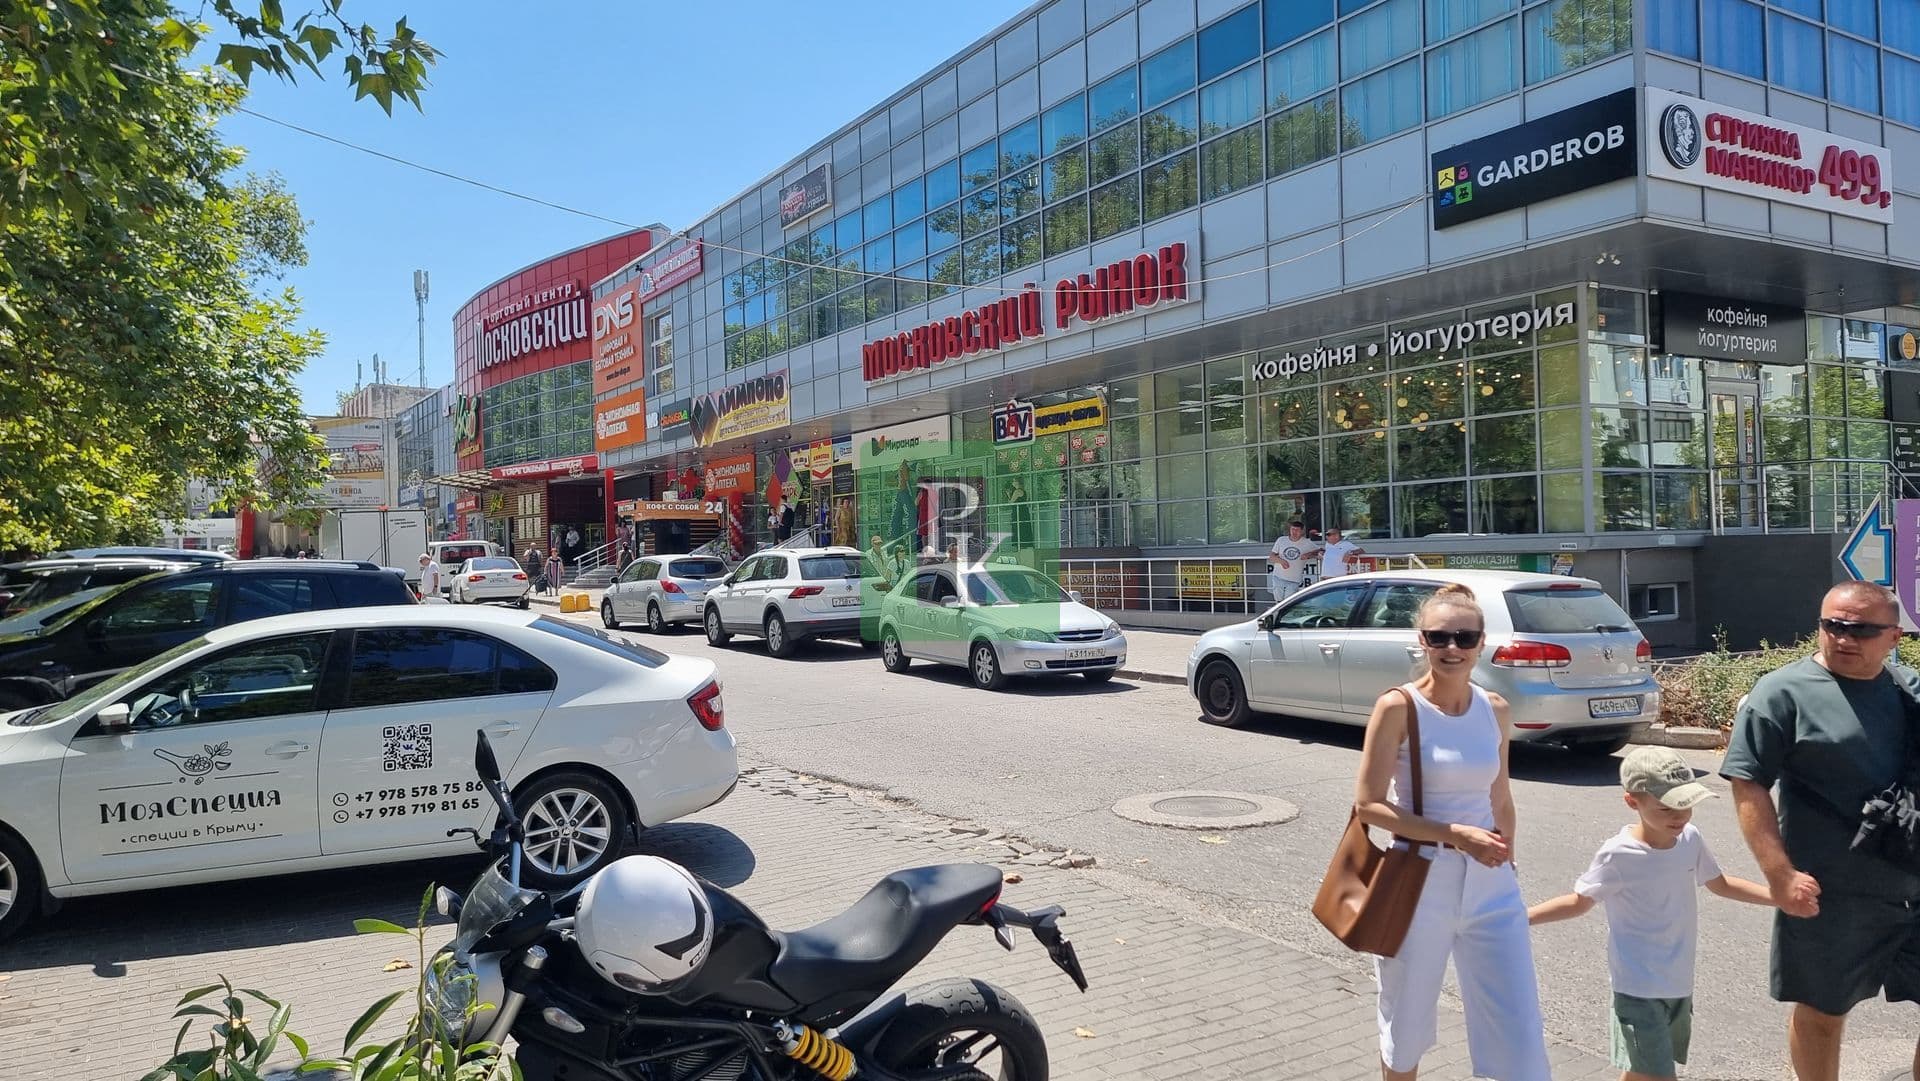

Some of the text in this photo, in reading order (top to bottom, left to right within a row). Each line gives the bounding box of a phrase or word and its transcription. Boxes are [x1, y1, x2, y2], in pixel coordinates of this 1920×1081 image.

[1705, 112, 1802, 160] СТРИЖКА
[1477, 124, 1625, 187] GARDEROB
[1705, 146, 1816, 194] МАНИКЮР
[594, 290, 634, 340] DNS
[862, 242, 1188, 382] МОСКОВСКИЙ РЫНОК
[1707, 307, 1767, 327] кофейня
[474, 291, 587, 371] Московский
[1252, 302, 1574, 381] кофейня йогуртерия
[1698, 328, 1776, 352] йогуртерия
[715, 463, 751, 477] ЭКОНОМНАЯ
[715, 478, 738, 490] АПТЕКА
[704, 501, 724, 514] 24
[1450, 554, 1517, 565] ЗООМАГАЗИН
[355, 781, 484, 802] +7 978 578 75 86
[100, 789, 281, 824] МояСпеция
[356, 798, 480, 819] +7 978 719 81 65
[130, 822, 256, 843] специи в Крыму
